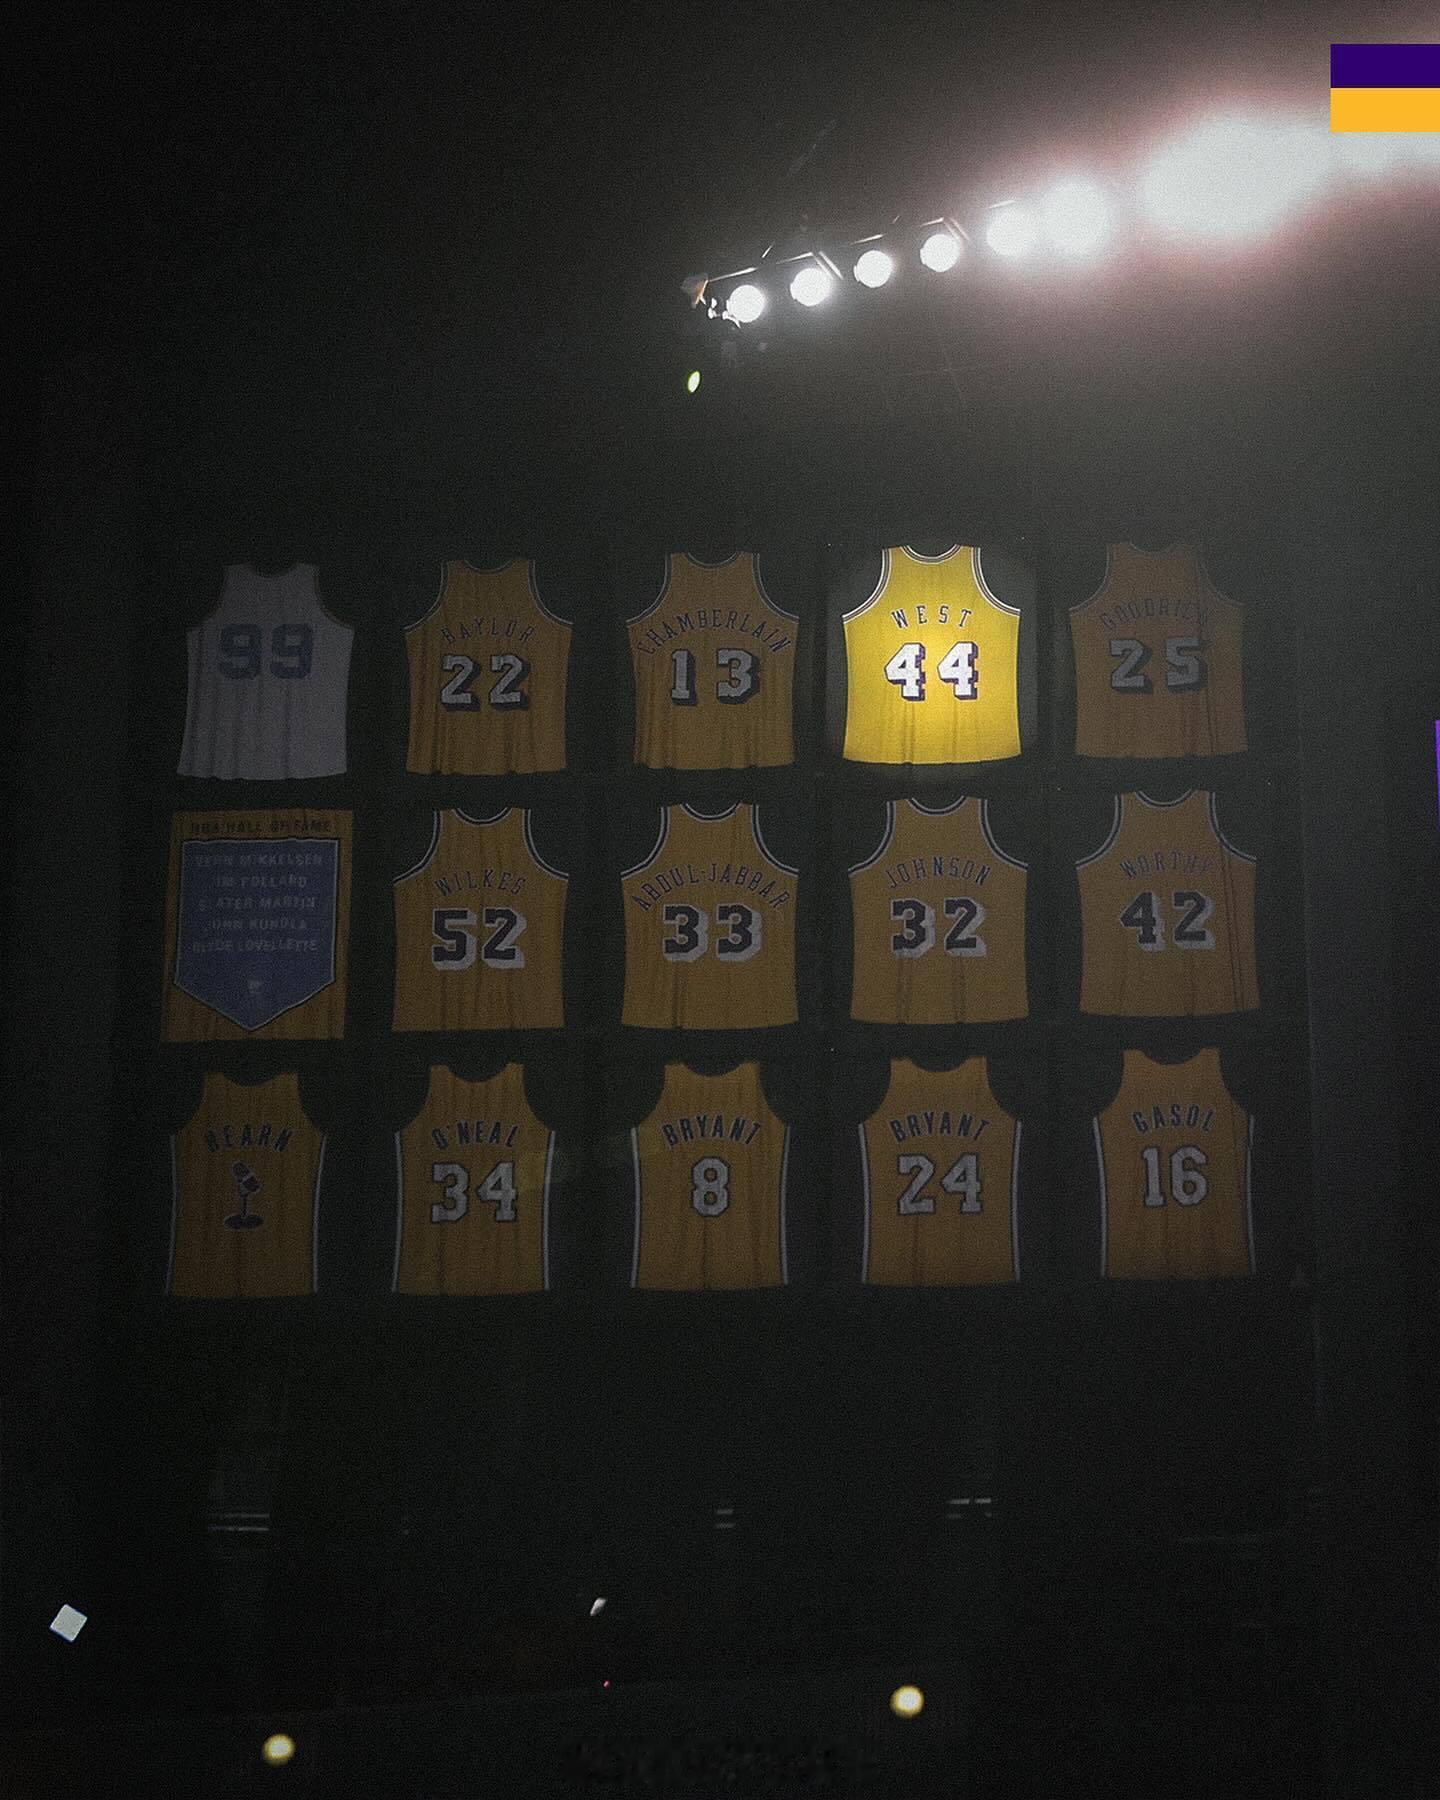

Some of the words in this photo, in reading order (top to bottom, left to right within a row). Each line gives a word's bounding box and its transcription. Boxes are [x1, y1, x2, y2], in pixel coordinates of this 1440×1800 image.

[441, 618, 535, 646] BAYLOR
[638, 608, 792, 656] CHAMBERLAIN
[890, 603, 975, 630] WEST
[218, 622, 314, 680] 99
[670, 647, 760, 706] 13
[883, 641, 979, 702] 44
[1109, 637, 1210, 694] 25
[440, 654, 530, 711] 22
[434, 869, 527, 897] WILKES
[631, 863, 792, 912] ABDUL-JABBAR
[886, 856, 992, 889] JOHNSON
[431, 907, 527, 971] 52
[662, 903, 762, 963] 33
[891, 897, 988, 960] 32
[1119, 890, 1216, 951] 42
[206, 1124, 294, 1153] HEARN
[431, 1120, 519, 1149] O'NEAL
[661, 1114, 763, 1149] BRYANT
[890, 1111, 990, 1144] BRYANT
[1133, 1104, 1215, 1133] GASOL
[431, 1161, 518, 1225] 34
[691, 1155, 731, 1217] 8
[898, 1153, 984, 1216] 24
[1142, 1146, 1209, 1208] 16
